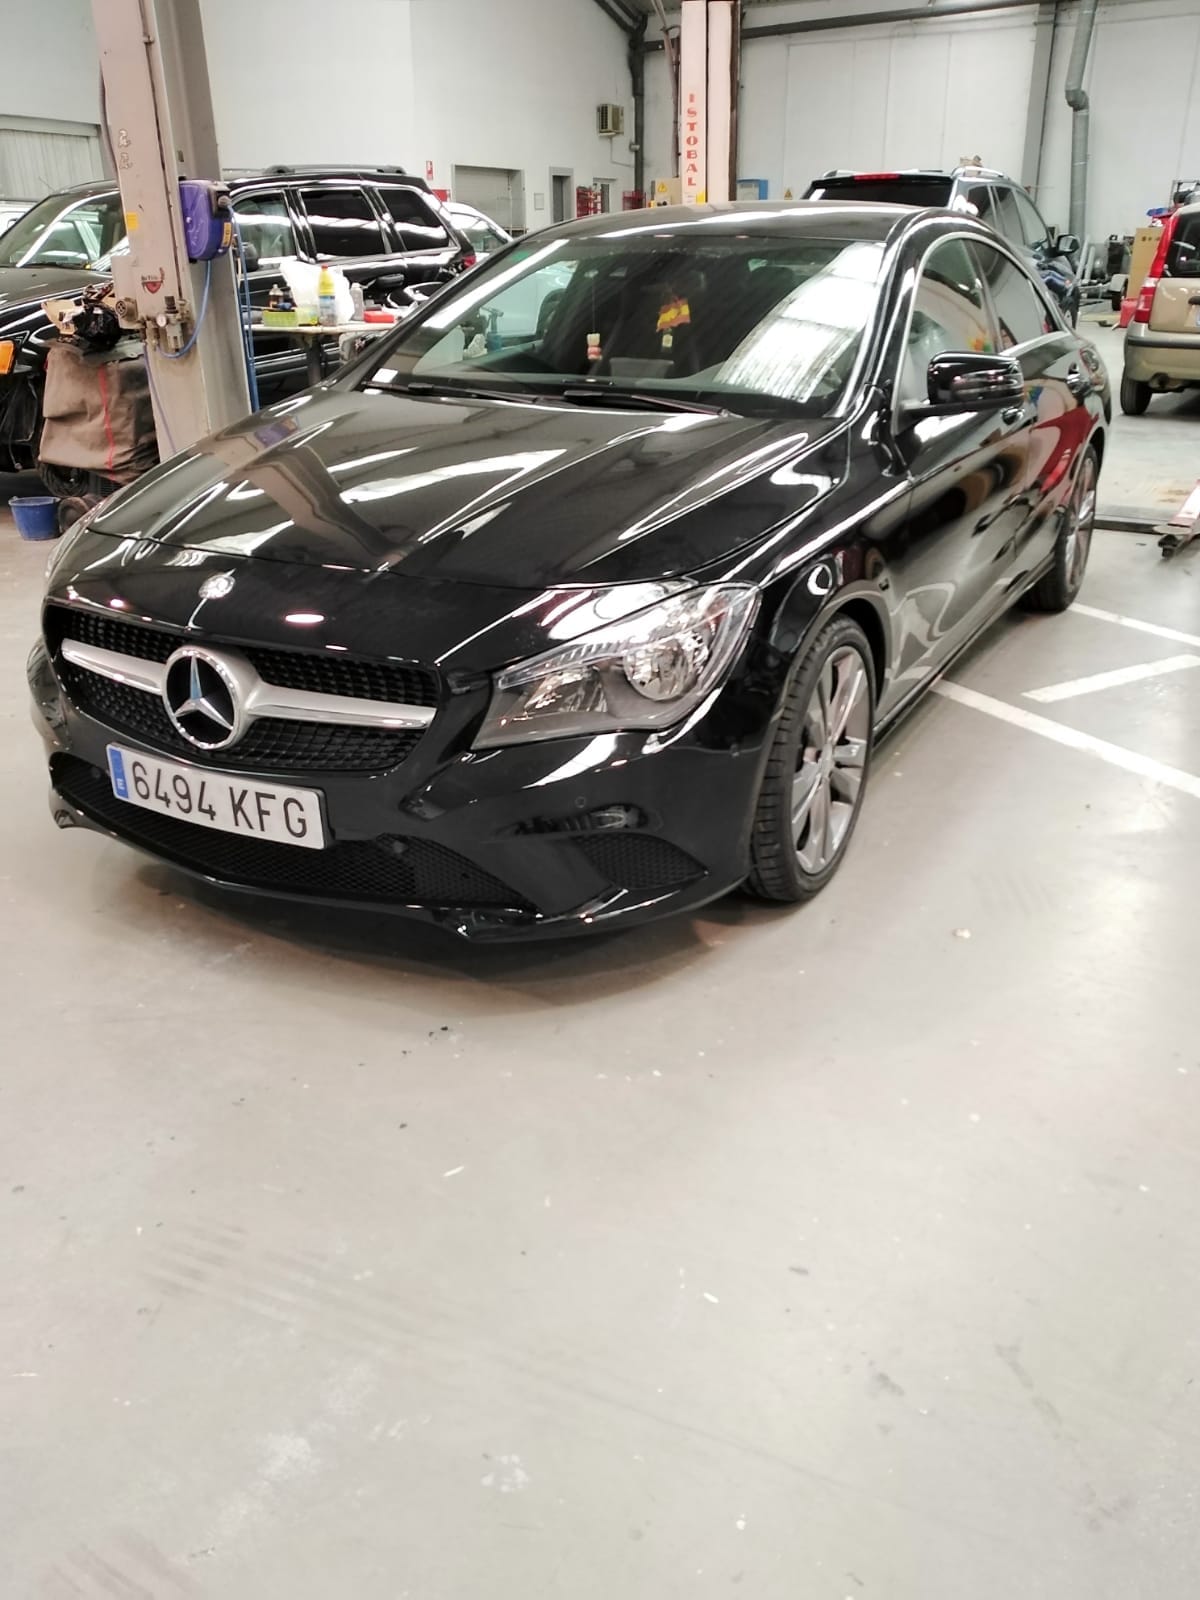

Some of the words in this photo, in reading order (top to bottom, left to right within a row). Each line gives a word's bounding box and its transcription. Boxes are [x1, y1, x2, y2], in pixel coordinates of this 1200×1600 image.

[686, 93, 698, 186] ISTOBAL
[132, 761, 216, 821] 6494
[229, 786, 307, 838] KFG
